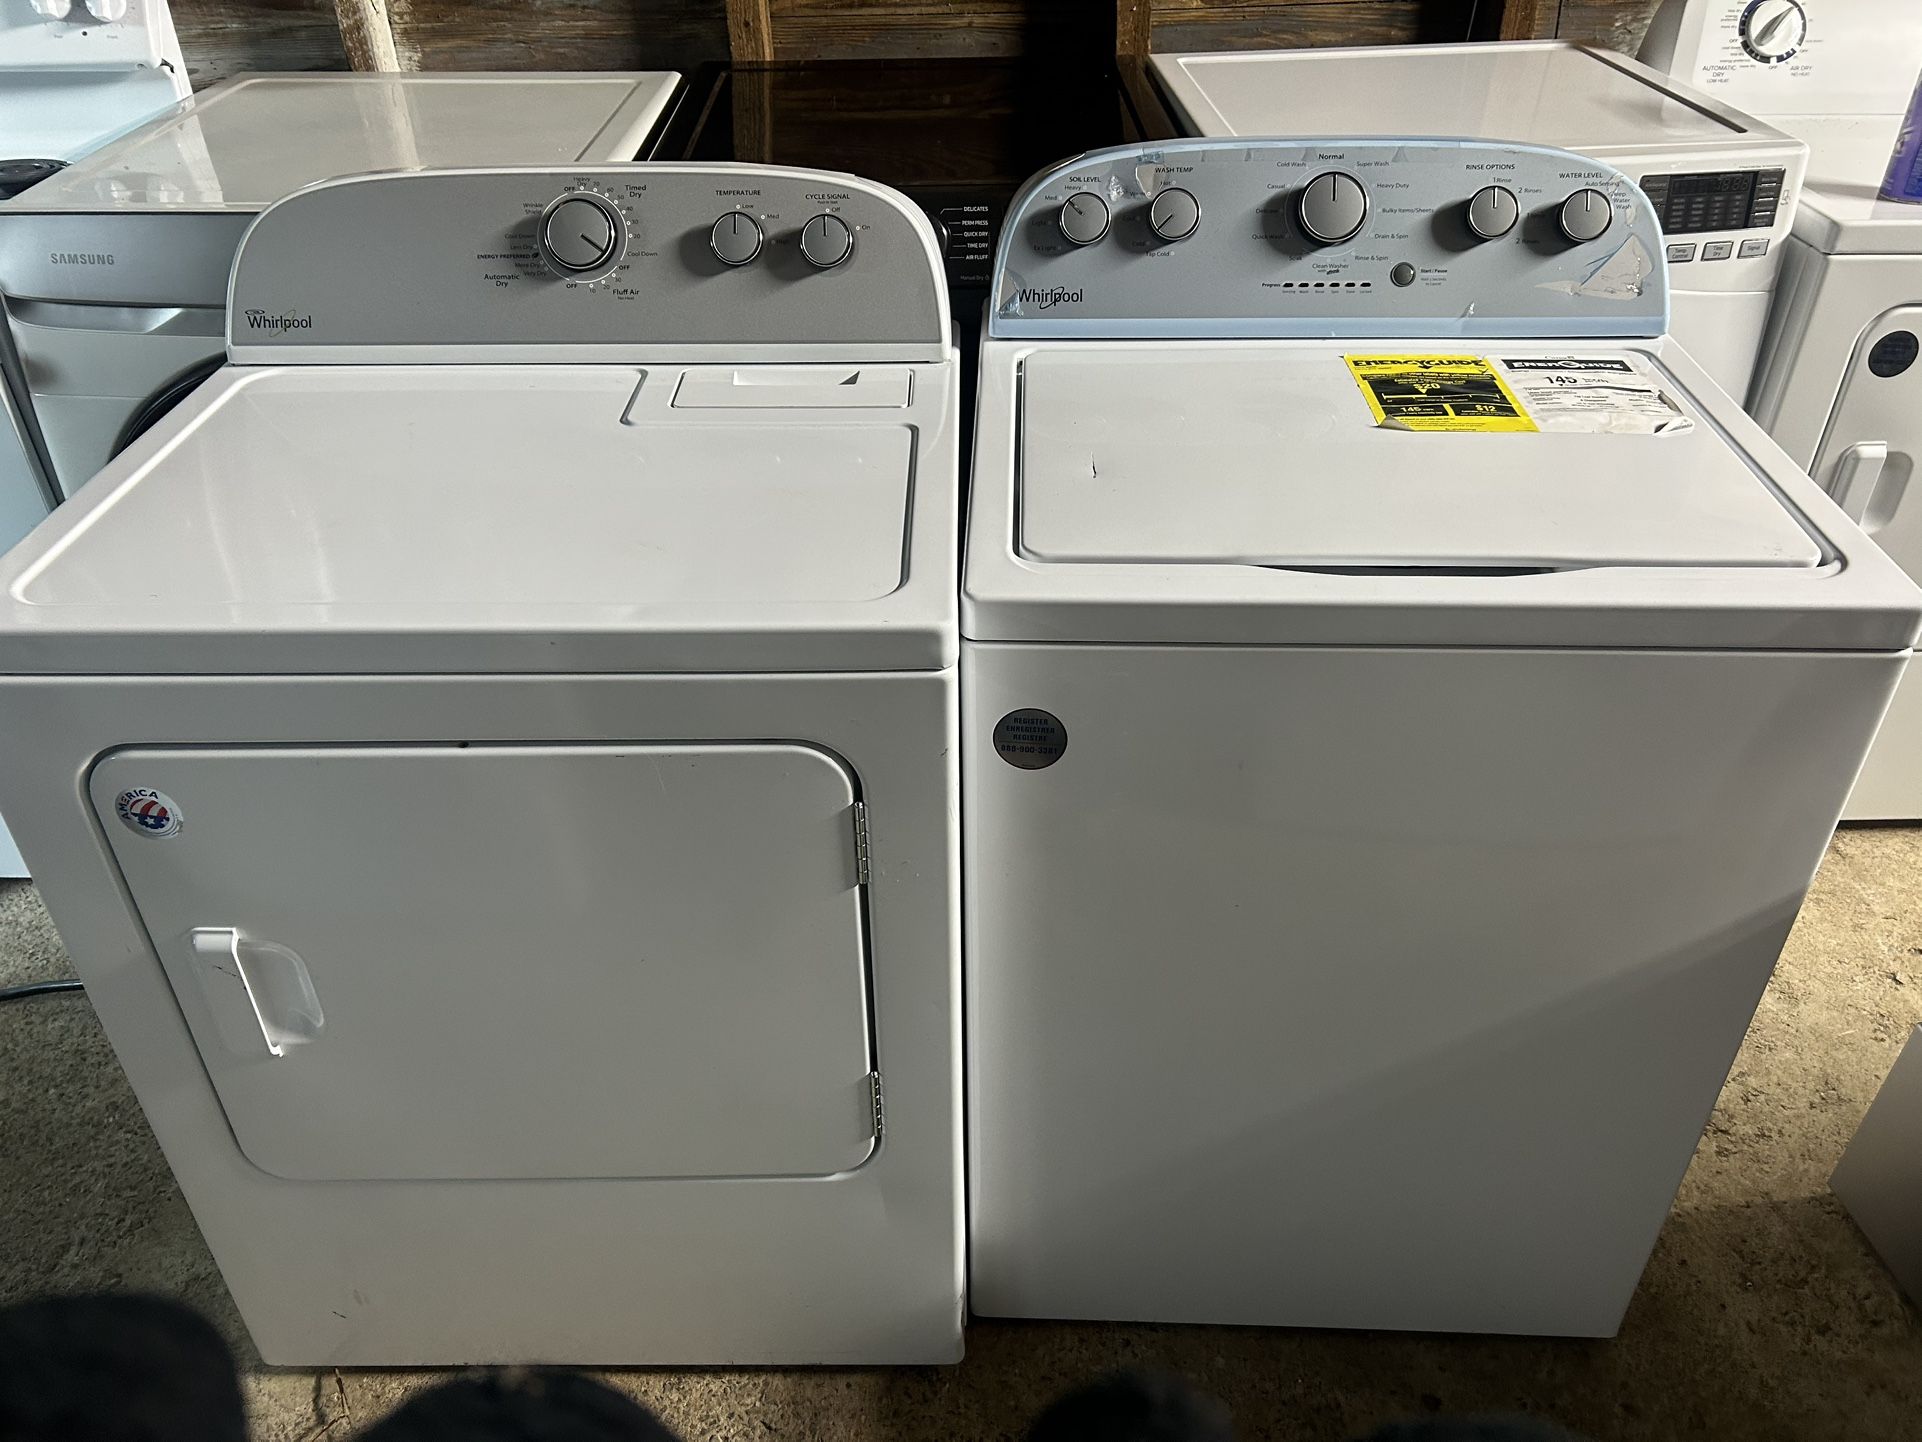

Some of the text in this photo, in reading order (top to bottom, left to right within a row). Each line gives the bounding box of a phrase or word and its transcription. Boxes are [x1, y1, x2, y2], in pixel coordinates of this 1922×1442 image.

[50, 252, 115, 266] SAMSUNG
[1019, 288, 1083, 307] Whirlpool
[246, 313, 312, 333] Whirlpool
[1352, 360, 1486, 368] ENERGYGUIDE
[1545, 376, 1578, 384] 145
[1013, 717, 1048, 726] REGISTER
[118, 789, 159, 820] AMERICA
